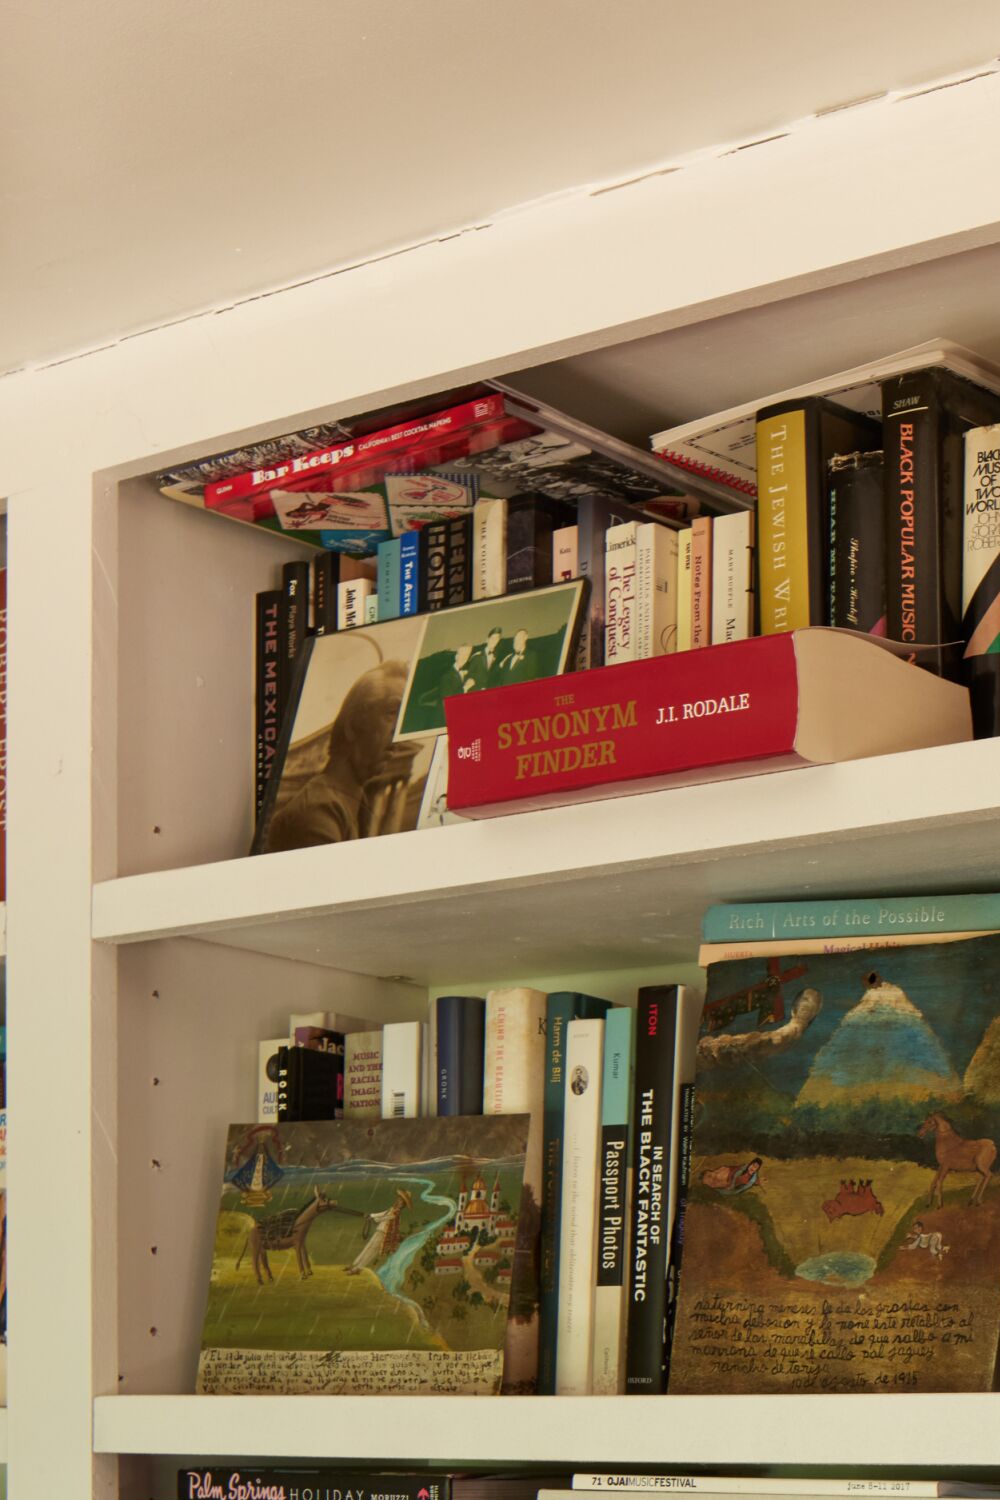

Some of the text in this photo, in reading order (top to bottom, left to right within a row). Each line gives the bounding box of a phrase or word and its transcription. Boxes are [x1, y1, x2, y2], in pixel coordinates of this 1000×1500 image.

[252, 445, 354, 486] Bar Keeps
[980, 474, 997, 487] OF
[768, 425, 788, 570] THE JEWISH
[899, 423, 916, 642] BLACK POPULAR MUSIC
[605, 567, 620, 658] of Conquest
[618, 561, 636, 649] The Legacy
[264, 603, 279, 779] THE MEXICAN
[554, 694, 575, 707] THE
[656, 693, 750, 725] J.I. RODALE
[498, 700, 638, 750] SYNONYM
[515, 740, 616, 780] FINDER
[729, 901, 945, 930] Rich Arts Possible
[647, 1003, 658, 1036] ITON
[278, 1070, 287, 1110] ROCK
[602, 1140, 624, 1269] Passport Photos
[634, 1089, 653, 1303] THE BLACK FANTASTIC
[649, 1146, 663, 1244] IN SEARCH OF
